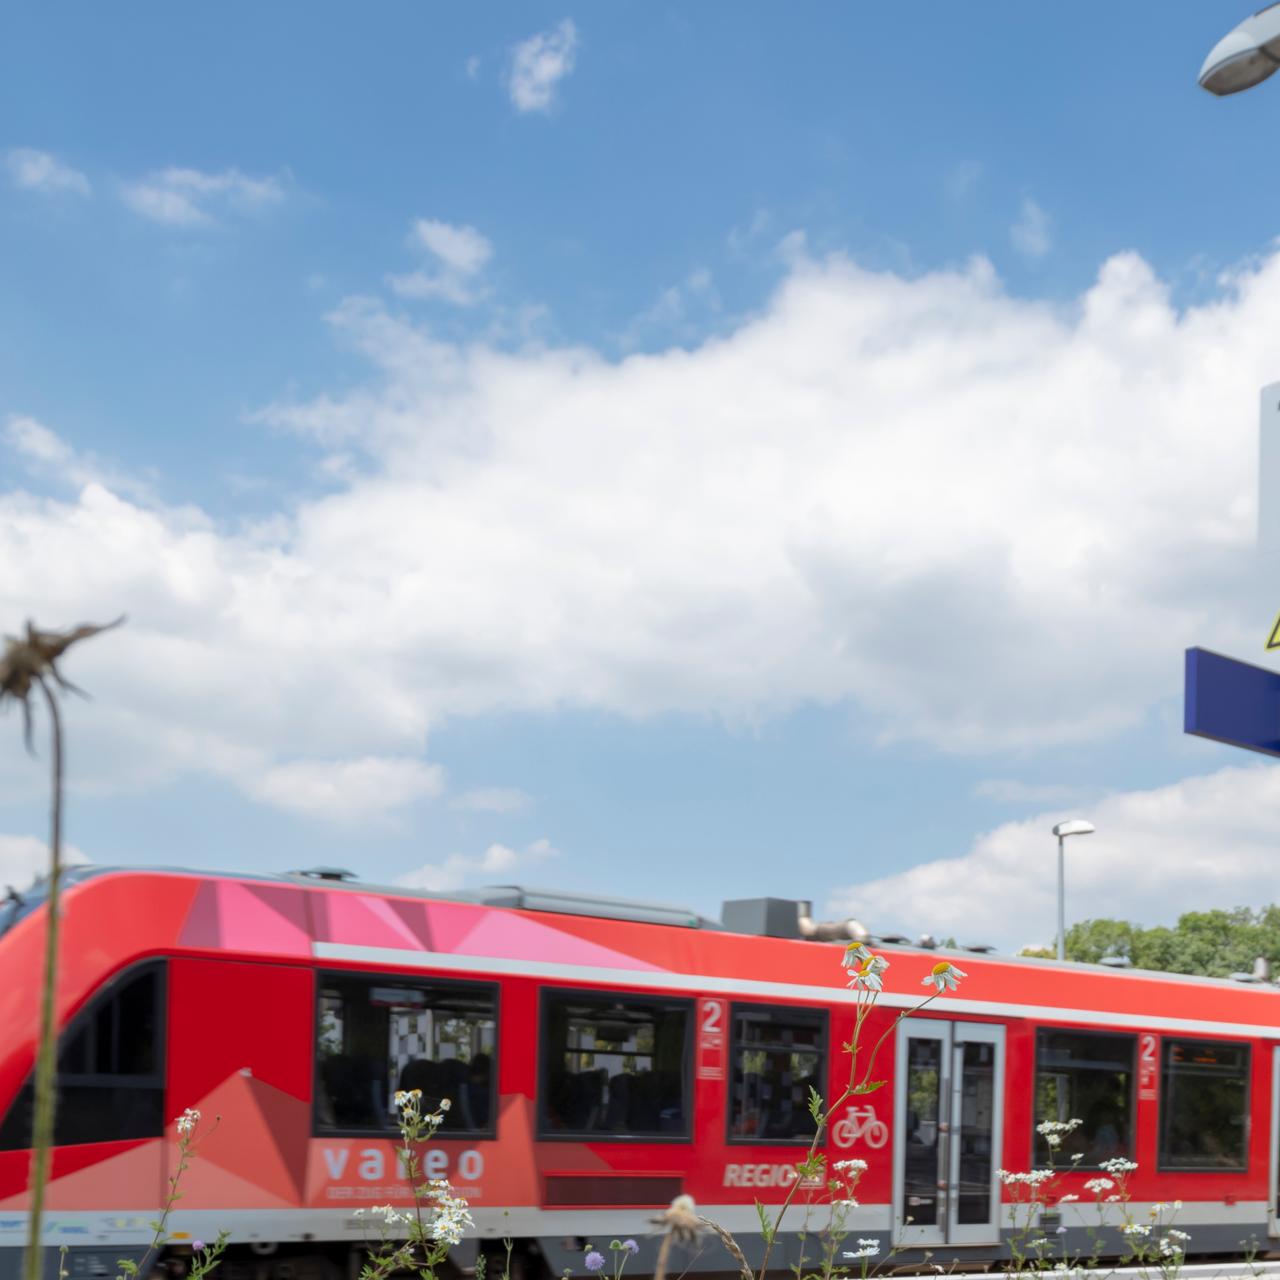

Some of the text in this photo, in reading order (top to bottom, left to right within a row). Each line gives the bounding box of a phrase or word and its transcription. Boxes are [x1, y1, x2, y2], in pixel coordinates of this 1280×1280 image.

[702, 1001, 722, 1033] 2
[1141, 1035, 1157, 1061] 2
[723, 1164, 794, 1187] REGIO
